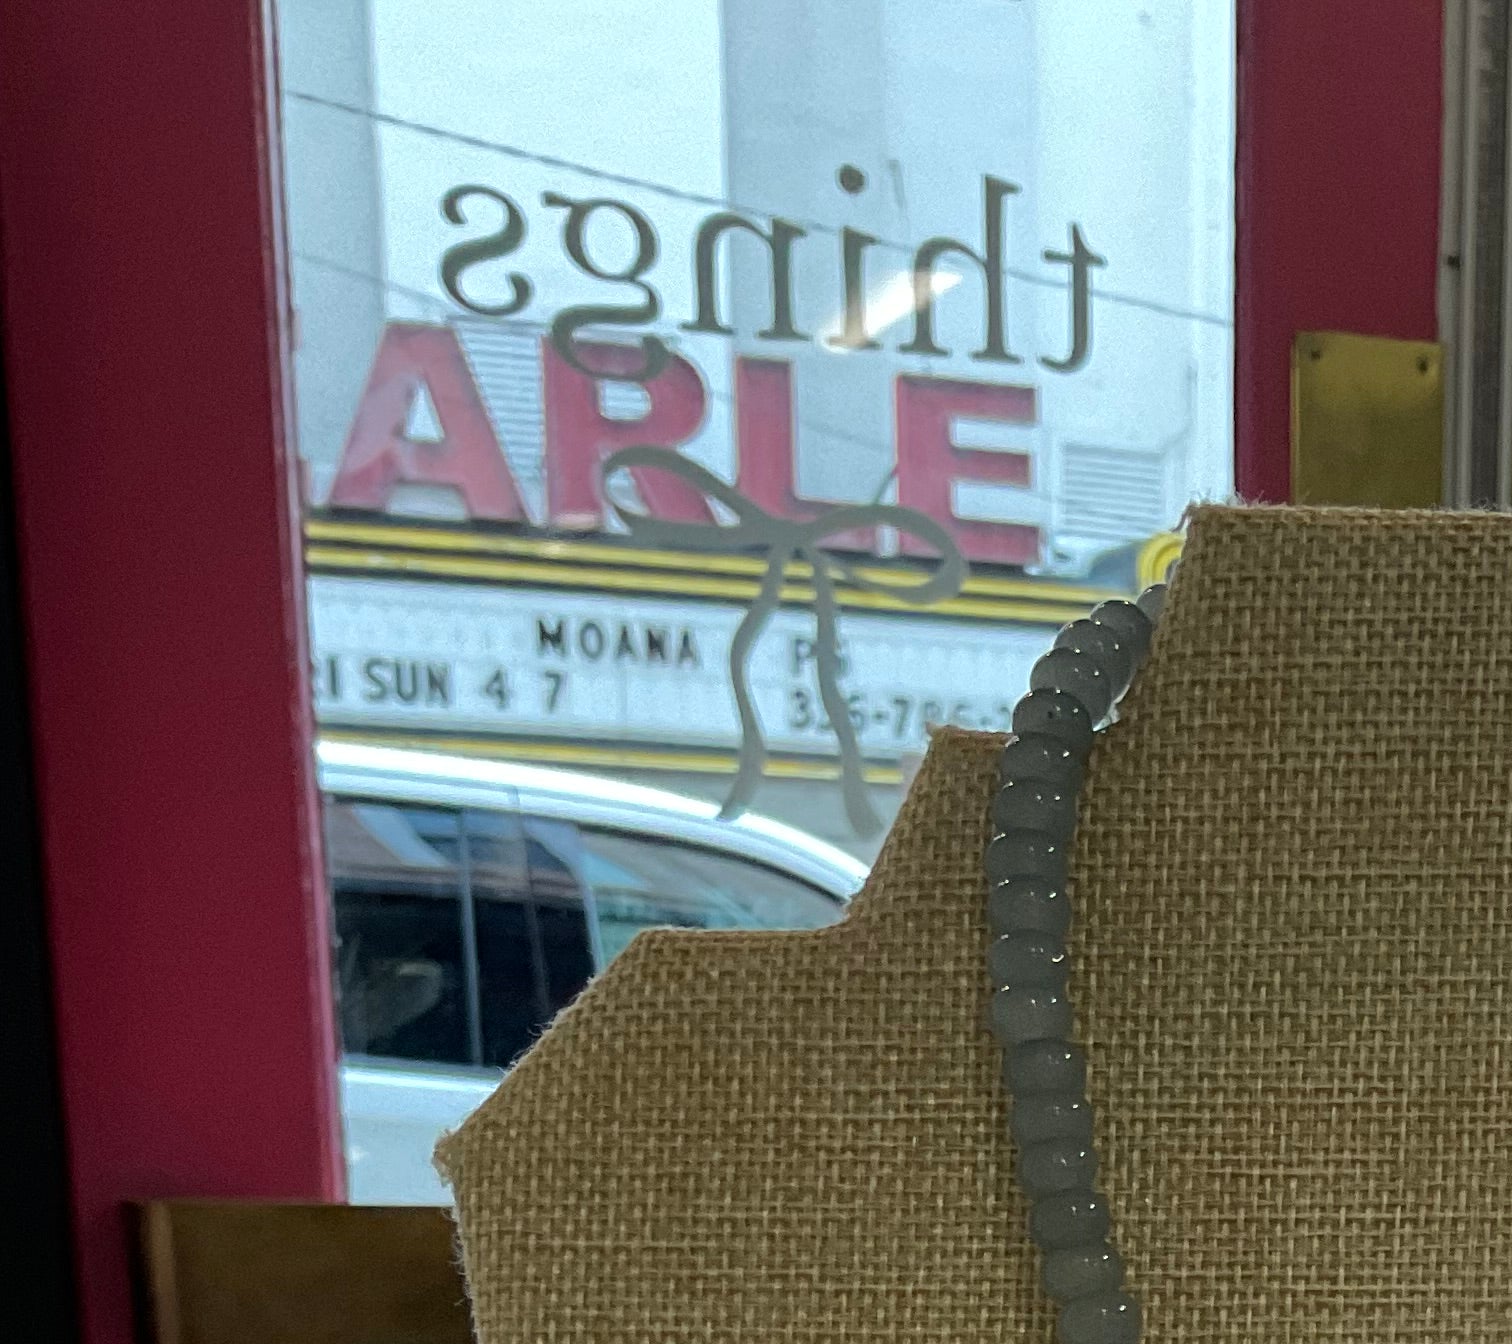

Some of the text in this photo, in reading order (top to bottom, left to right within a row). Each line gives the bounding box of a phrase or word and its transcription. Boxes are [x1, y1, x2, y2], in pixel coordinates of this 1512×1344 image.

[329, 321, 1041, 567] ARLE
[537, 618, 699, 667] MOANA
[364, 656, 450, 705] SUN
[484, 668, 509, 709] 4
[545, 672, 564, 713] 7
